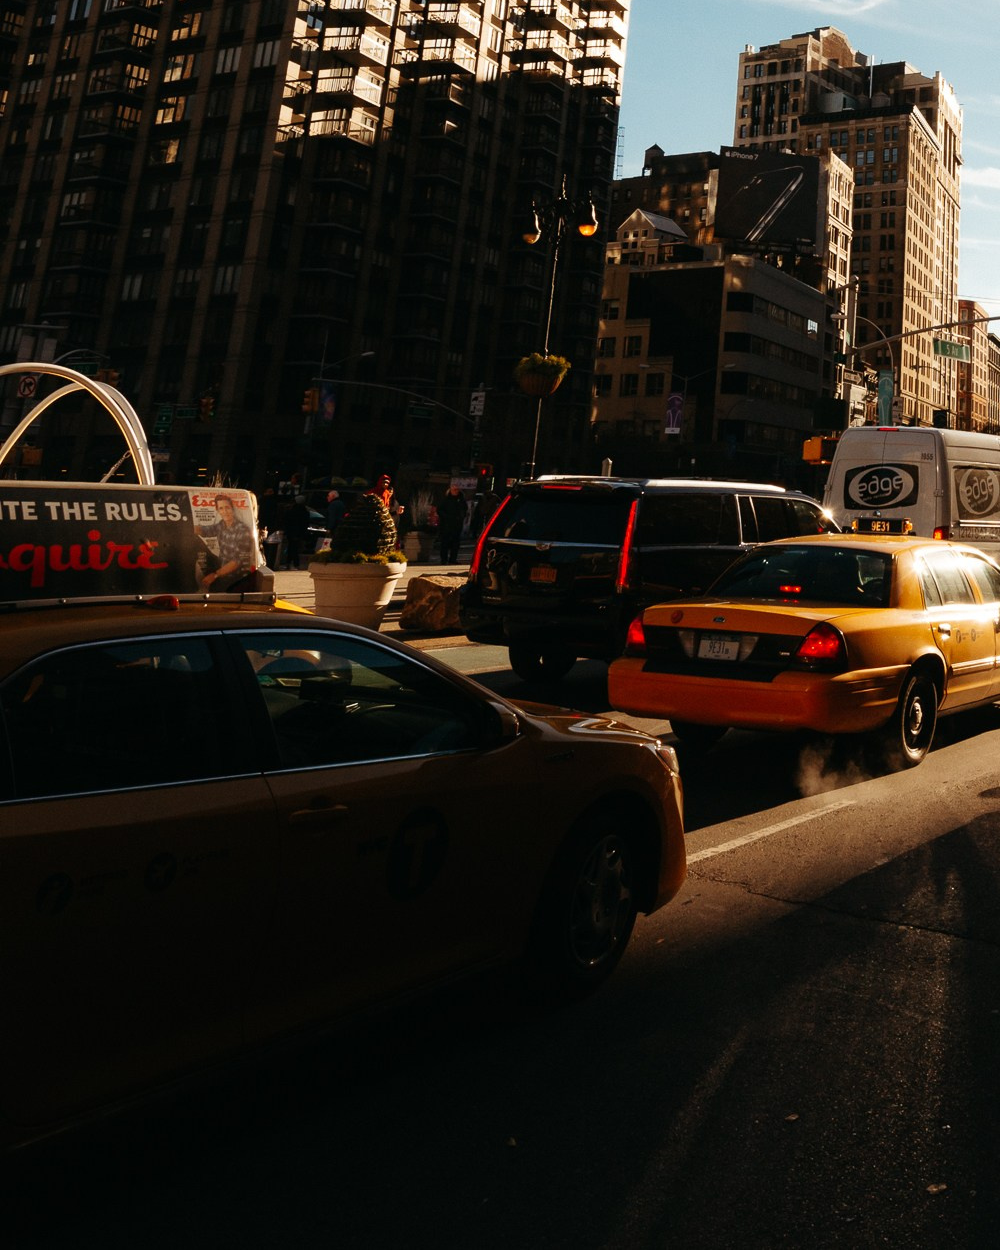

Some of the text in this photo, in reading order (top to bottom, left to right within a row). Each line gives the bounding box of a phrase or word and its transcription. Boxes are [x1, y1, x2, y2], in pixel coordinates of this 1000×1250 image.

[730, 151, 753, 160] iPhone
[858, 475, 904, 497] edge
[44, 501, 99, 521] THE
[105, 502, 188, 522] RULES.
[871, 520, 890, 532] 9E31
